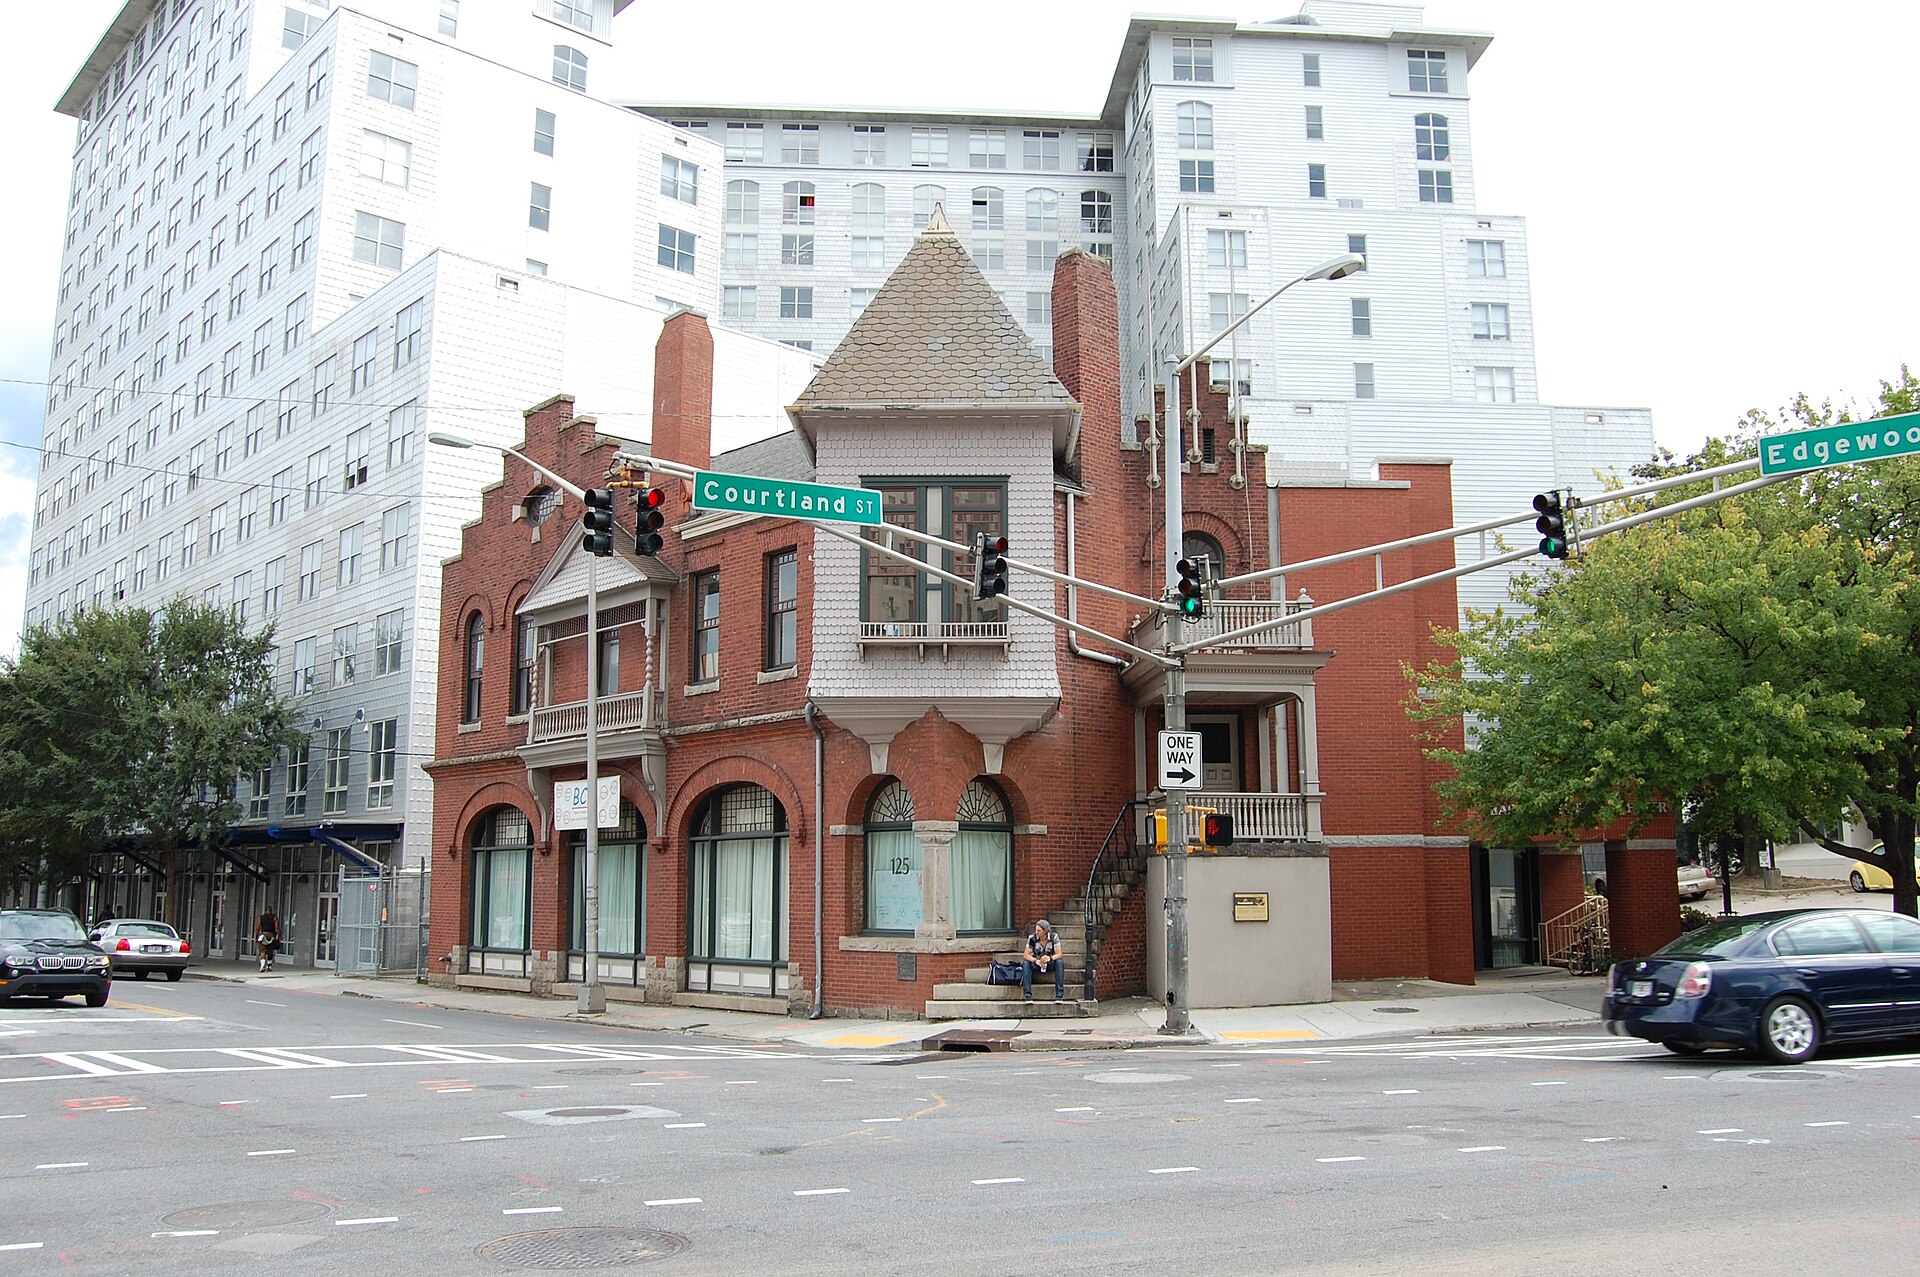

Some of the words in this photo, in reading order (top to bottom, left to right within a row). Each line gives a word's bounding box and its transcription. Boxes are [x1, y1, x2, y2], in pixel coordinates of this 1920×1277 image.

[703, 480, 846, 514] Courtland
[856, 499, 874, 515] ST
[1166, 736, 1194, 749] ONE
[1166, 751, 1195, 765] WAY
[890, 857, 910, 875] 125
